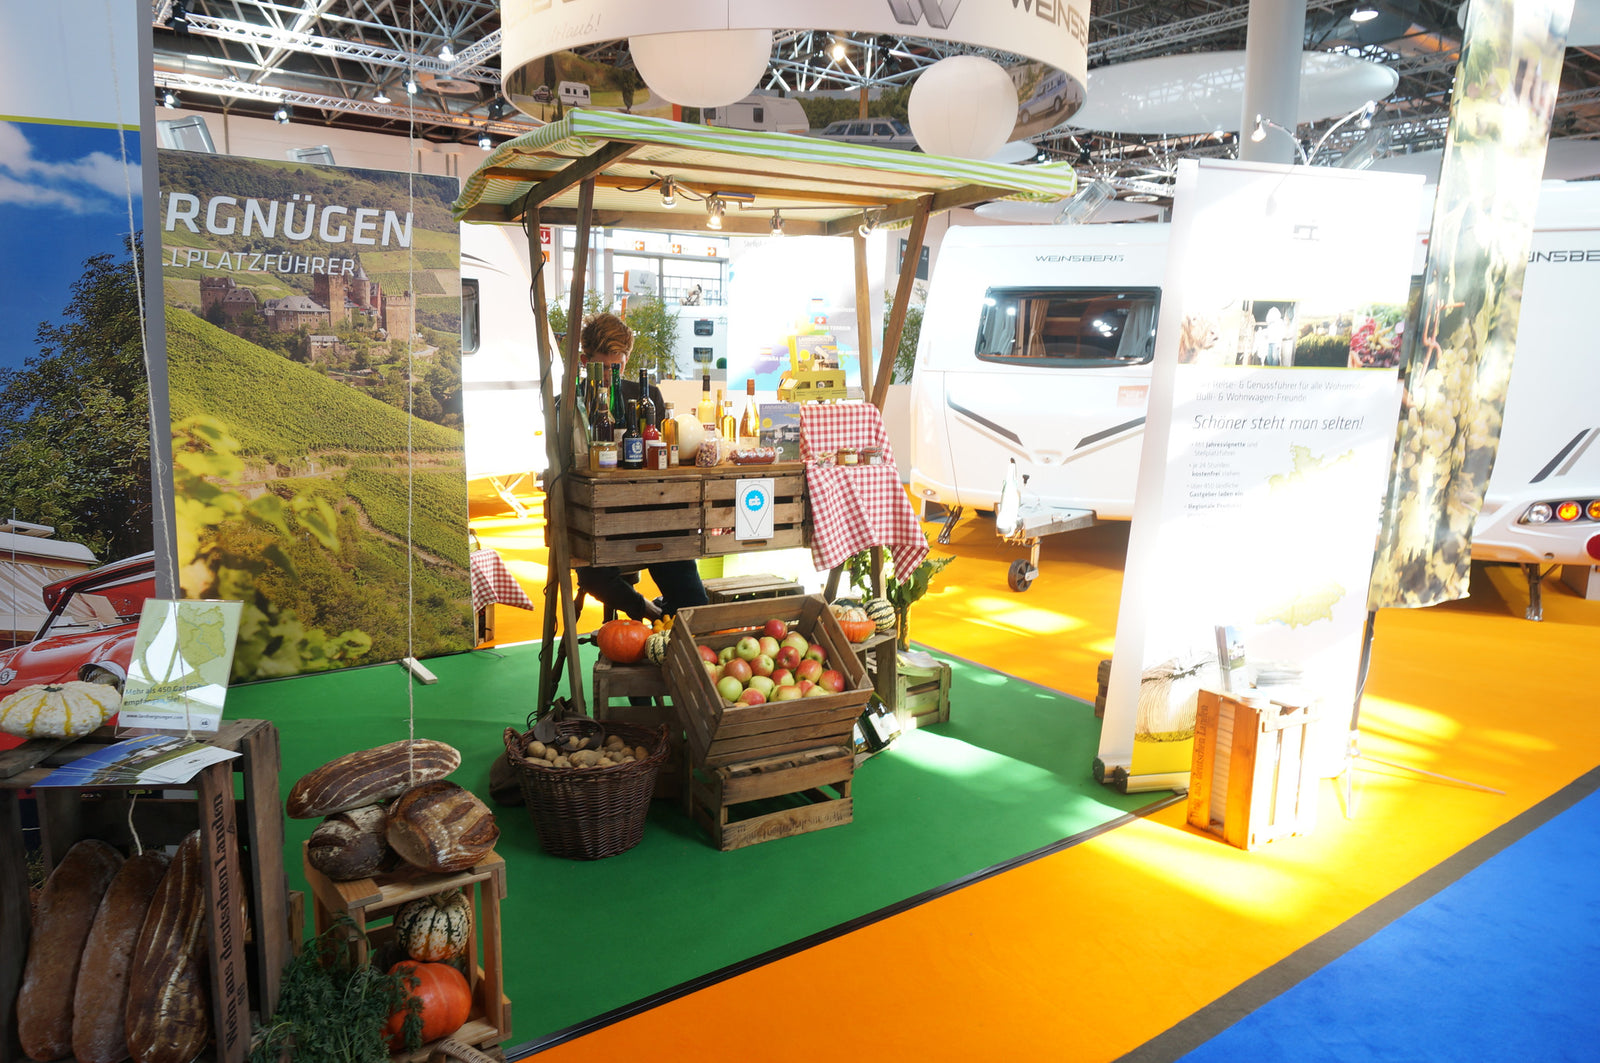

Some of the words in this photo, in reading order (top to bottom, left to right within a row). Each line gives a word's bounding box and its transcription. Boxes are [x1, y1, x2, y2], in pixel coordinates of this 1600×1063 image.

[160, 191, 414, 248] RGNÜGEN
[1527, 250, 1600, 263] INSBE
[1194, 414, 1248, 430] Schöner
[1250, 415, 1285, 430] steht
[1288, 418, 1319, 430] man
[1322, 415, 1365, 431] selten!
[212, 793, 228, 870] Landen
[217, 870, 232, 961] deutschen
[223, 961, 235, 998] aus
[226, 1000, 239, 1049] Wein
